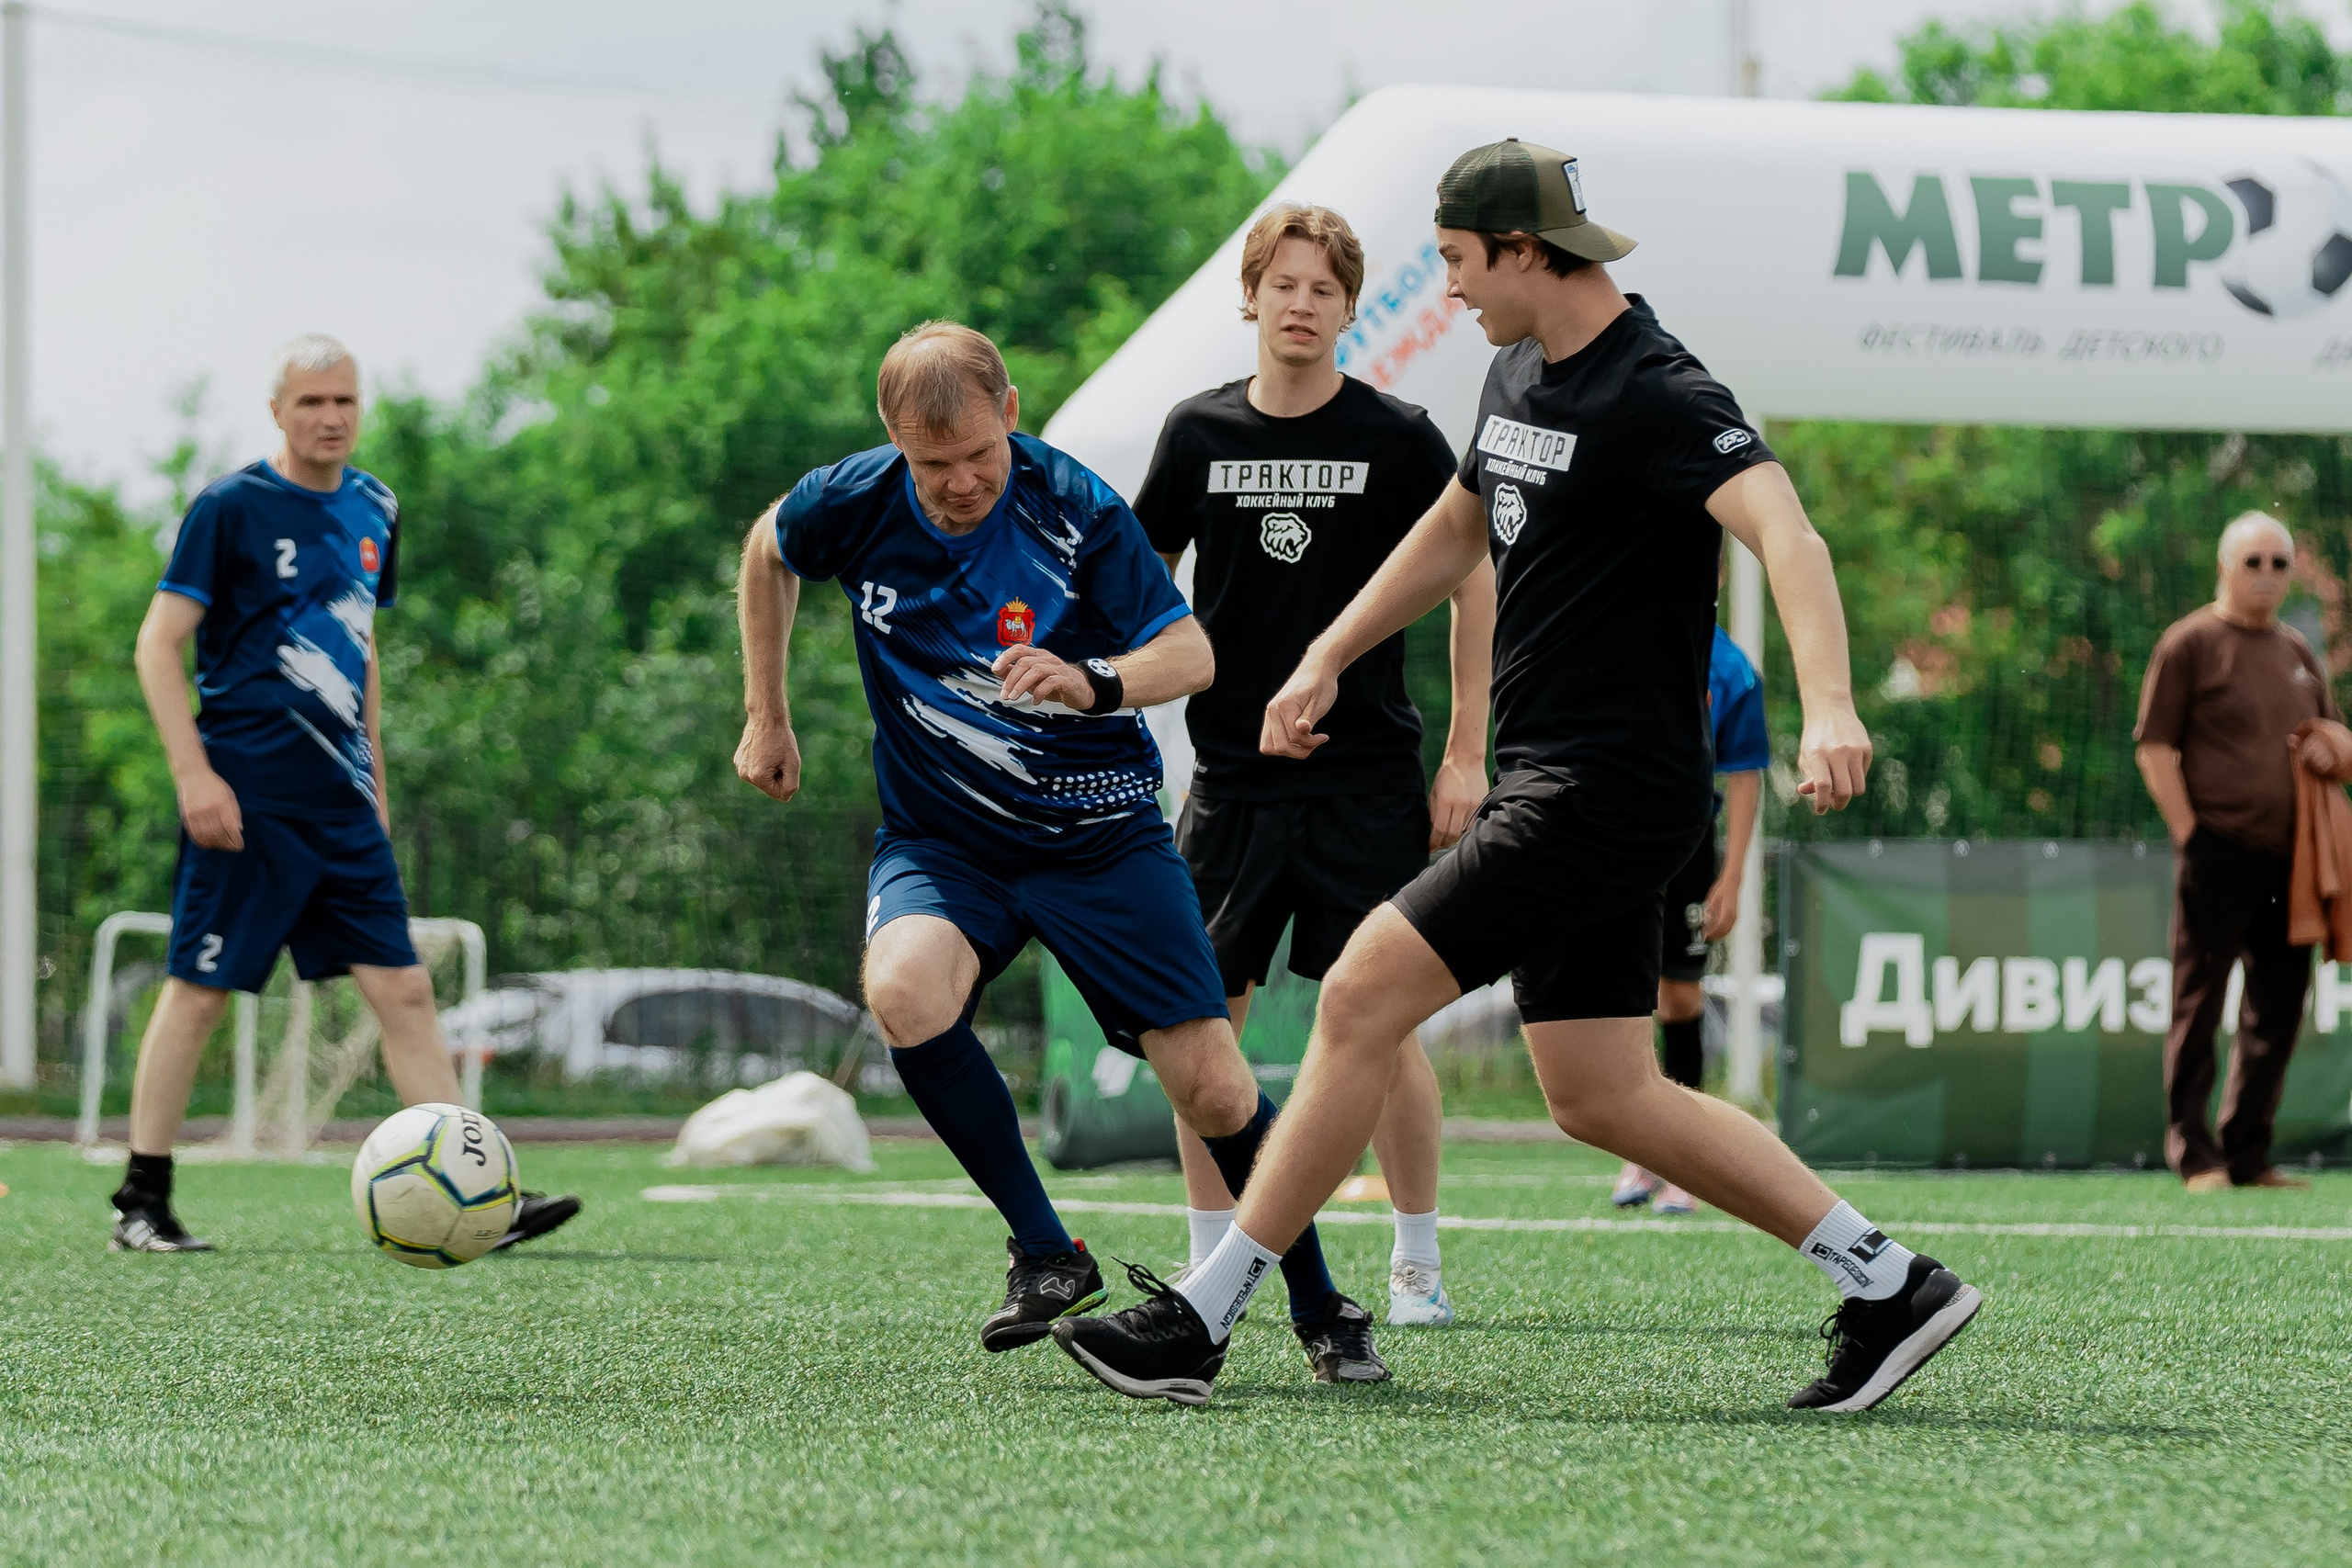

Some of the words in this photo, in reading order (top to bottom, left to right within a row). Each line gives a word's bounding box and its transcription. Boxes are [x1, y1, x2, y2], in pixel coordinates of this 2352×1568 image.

[1485, 420, 1566, 465] ТРАКТОР
[1220, 463, 1354, 490] ТРАКТОР
[1485, 457, 1529, 480] ХОККЕЙНЫЙ
[1524, 468, 1547, 485] КЛУБ
[1236, 492, 1305, 508] ХОККЕЙНЫЙ
[1306, 495, 1336, 508] КЛУБ
[275, 538, 298, 578] 2
[861, 581, 897, 635] 12
[196, 933, 223, 973] 2
[1839, 931, 2352, 1048] Дивизн
[1219, 1275, 1257, 1330] TAPEDESIGN
